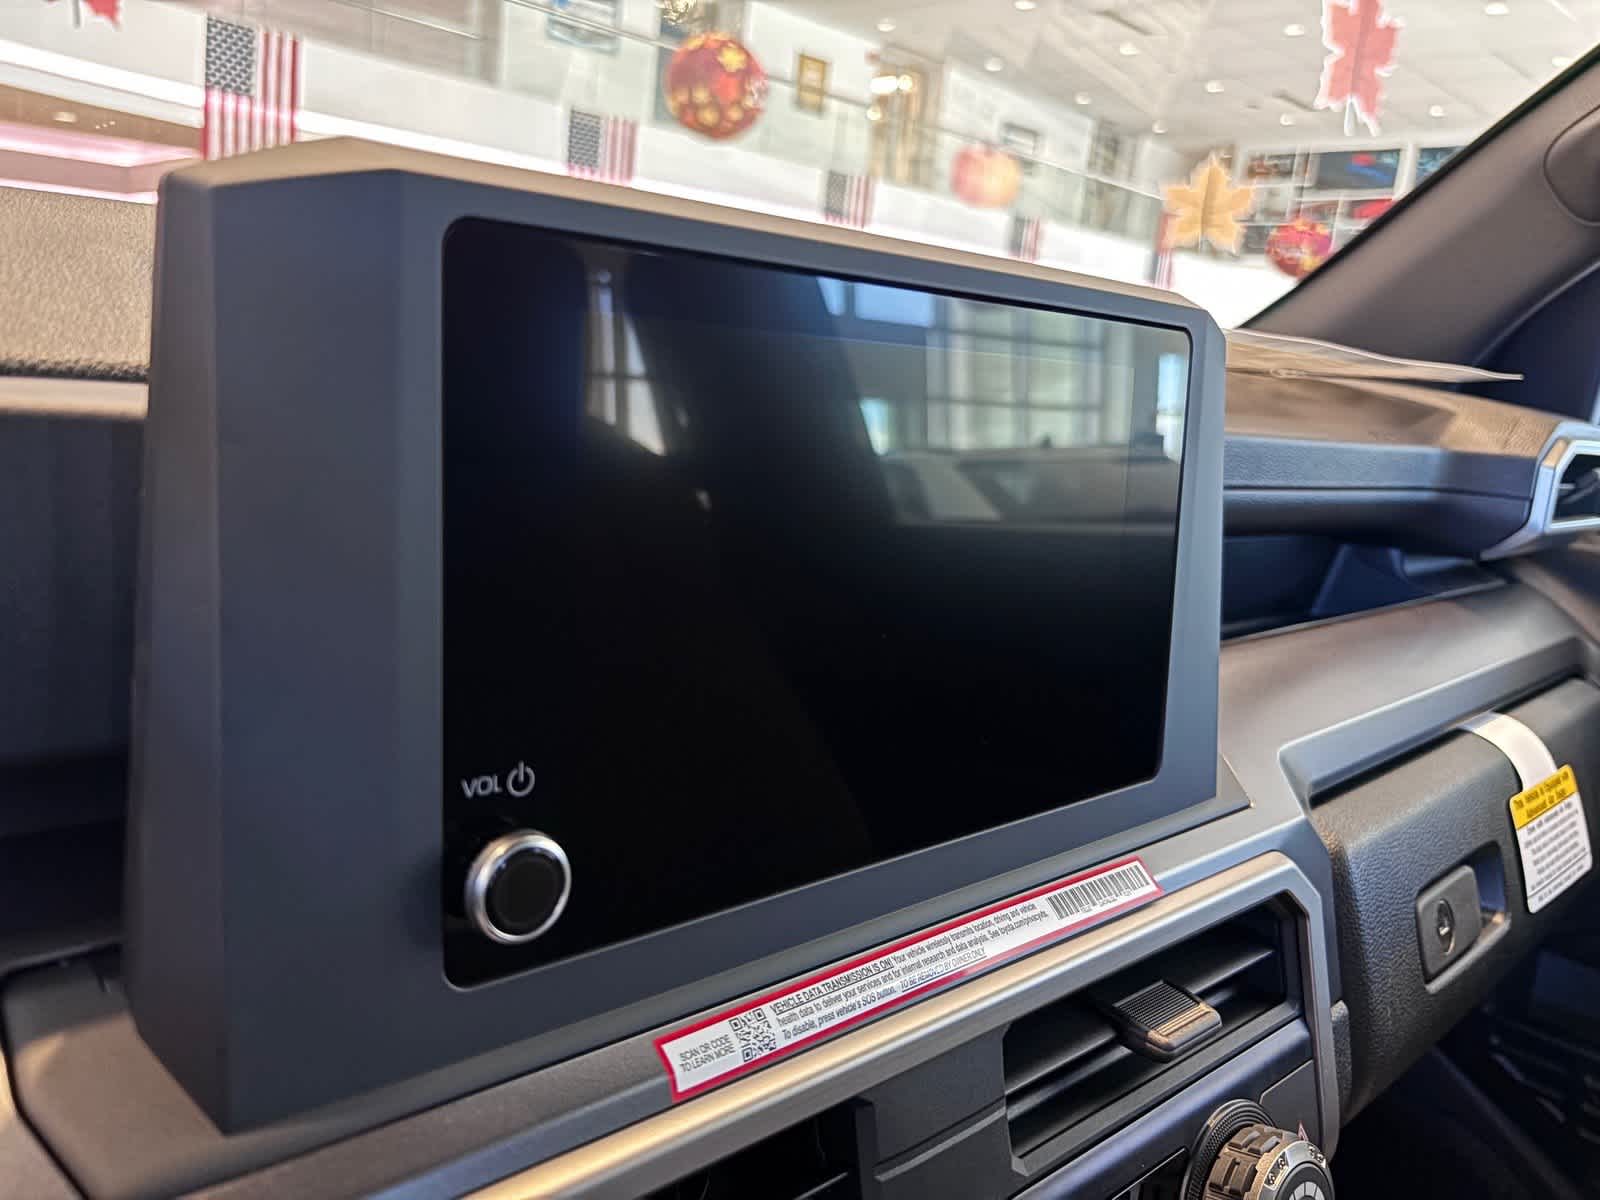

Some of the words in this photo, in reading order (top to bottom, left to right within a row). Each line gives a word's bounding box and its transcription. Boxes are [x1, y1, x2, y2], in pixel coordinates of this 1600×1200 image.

[461, 774, 502, 798] VOL
[770, 994, 803, 1013] VEHICLE
[803, 986, 823, 1000] DATA
[822, 966, 873, 992] TRANSMISSION
[871, 963, 880, 973] IS
[907, 945, 926, 958] vehicle
[925, 935, 952, 952] wirelessly
[950, 927, 974, 942] transmits
[993, 912, 1012, 924] driving
[1010, 909, 1020, 918] and
[776, 1011, 799, 1025] health
[799, 1004, 815, 1016] data
[813, 1002, 821, 1010] to
[823, 994, 842, 1006] deliver
[842, 988, 856, 1001] your
[857, 978, 880, 992] services
[880, 973, 894, 983] and
[892, 970, 901, 978] for
[901, 961, 922, 974] internal
[921, 951, 945, 966] research
[945, 947, 956, 957] and
[954, 942, 968, 953] data
[987, 929, 1001, 939] See
[782, 1029, 791, 1039] To
[792, 1019, 817, 1035] disable,
[818, 1012, 835, 1026] press
[861, 995, 876, 1005] SOS
[901, 980, 909, 988] TO
[944, 960, 952, 969] BY
[951, 954, 971, 966] OWNER
[971, 947, 985, 958] ONLY
[680, 1048, 700, 1061] SCAN
[710, 1036, 730, 1049] CODE
[681, 1062, 691, 1072] TO
[691, 1053, 714, 1068] LEARN
[713, 1045, 735, 1059] MORE
